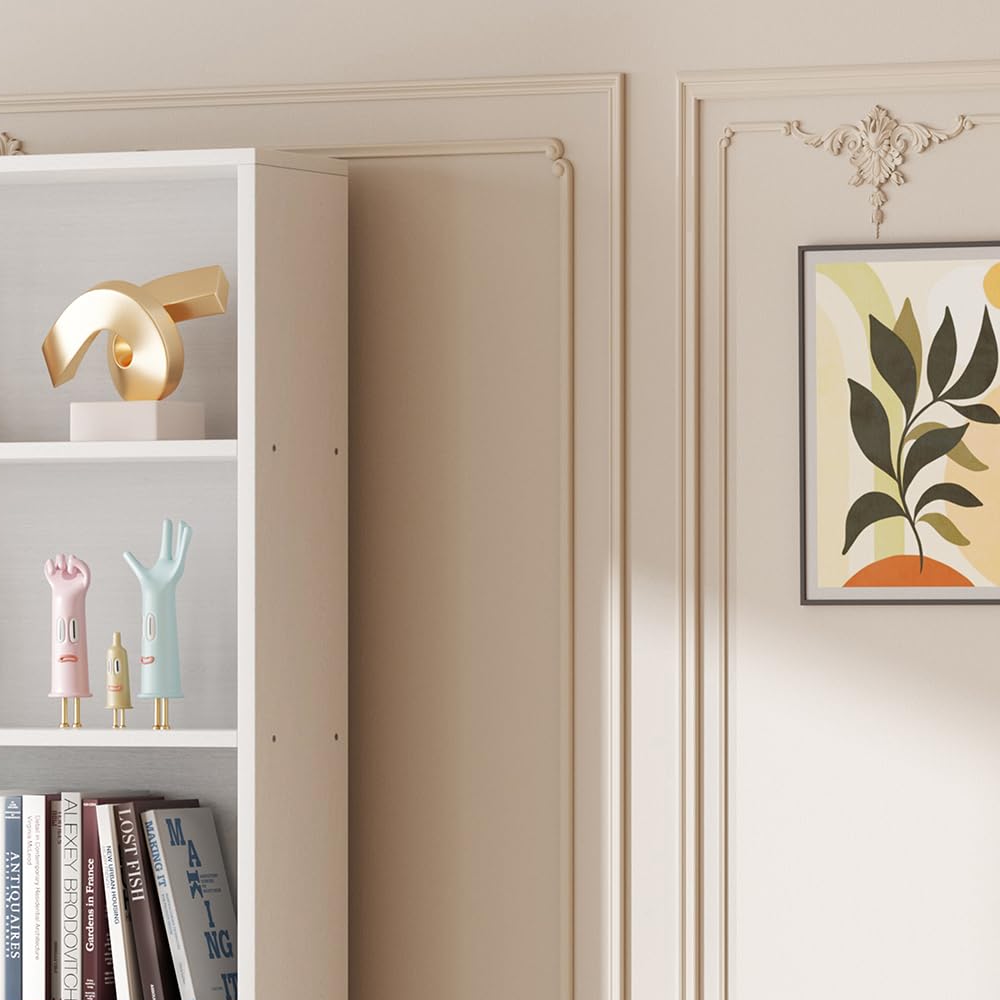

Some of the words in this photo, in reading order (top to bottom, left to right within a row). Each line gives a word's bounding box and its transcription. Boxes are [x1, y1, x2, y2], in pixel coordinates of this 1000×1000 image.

[64, 798, 78, 872] ALEXEY
[118, 809, 138, 856] LOST
[145, 820, 163, 872] MAKING
[157, 875, 167, 887] IT
[85, 858, 95, 893] France
[107, 864, 116, 890] URBAN
[126, 860, 145, 902] FISH
[8, 851, 20, 959] ANTIQUAIRES
[87, 896, 95, 906] in
[110, 891, 120, 925] HOUSING
[64, 878, 78, 1000] BRODOVITCH
[85, 909, 95, 952] Gardens
